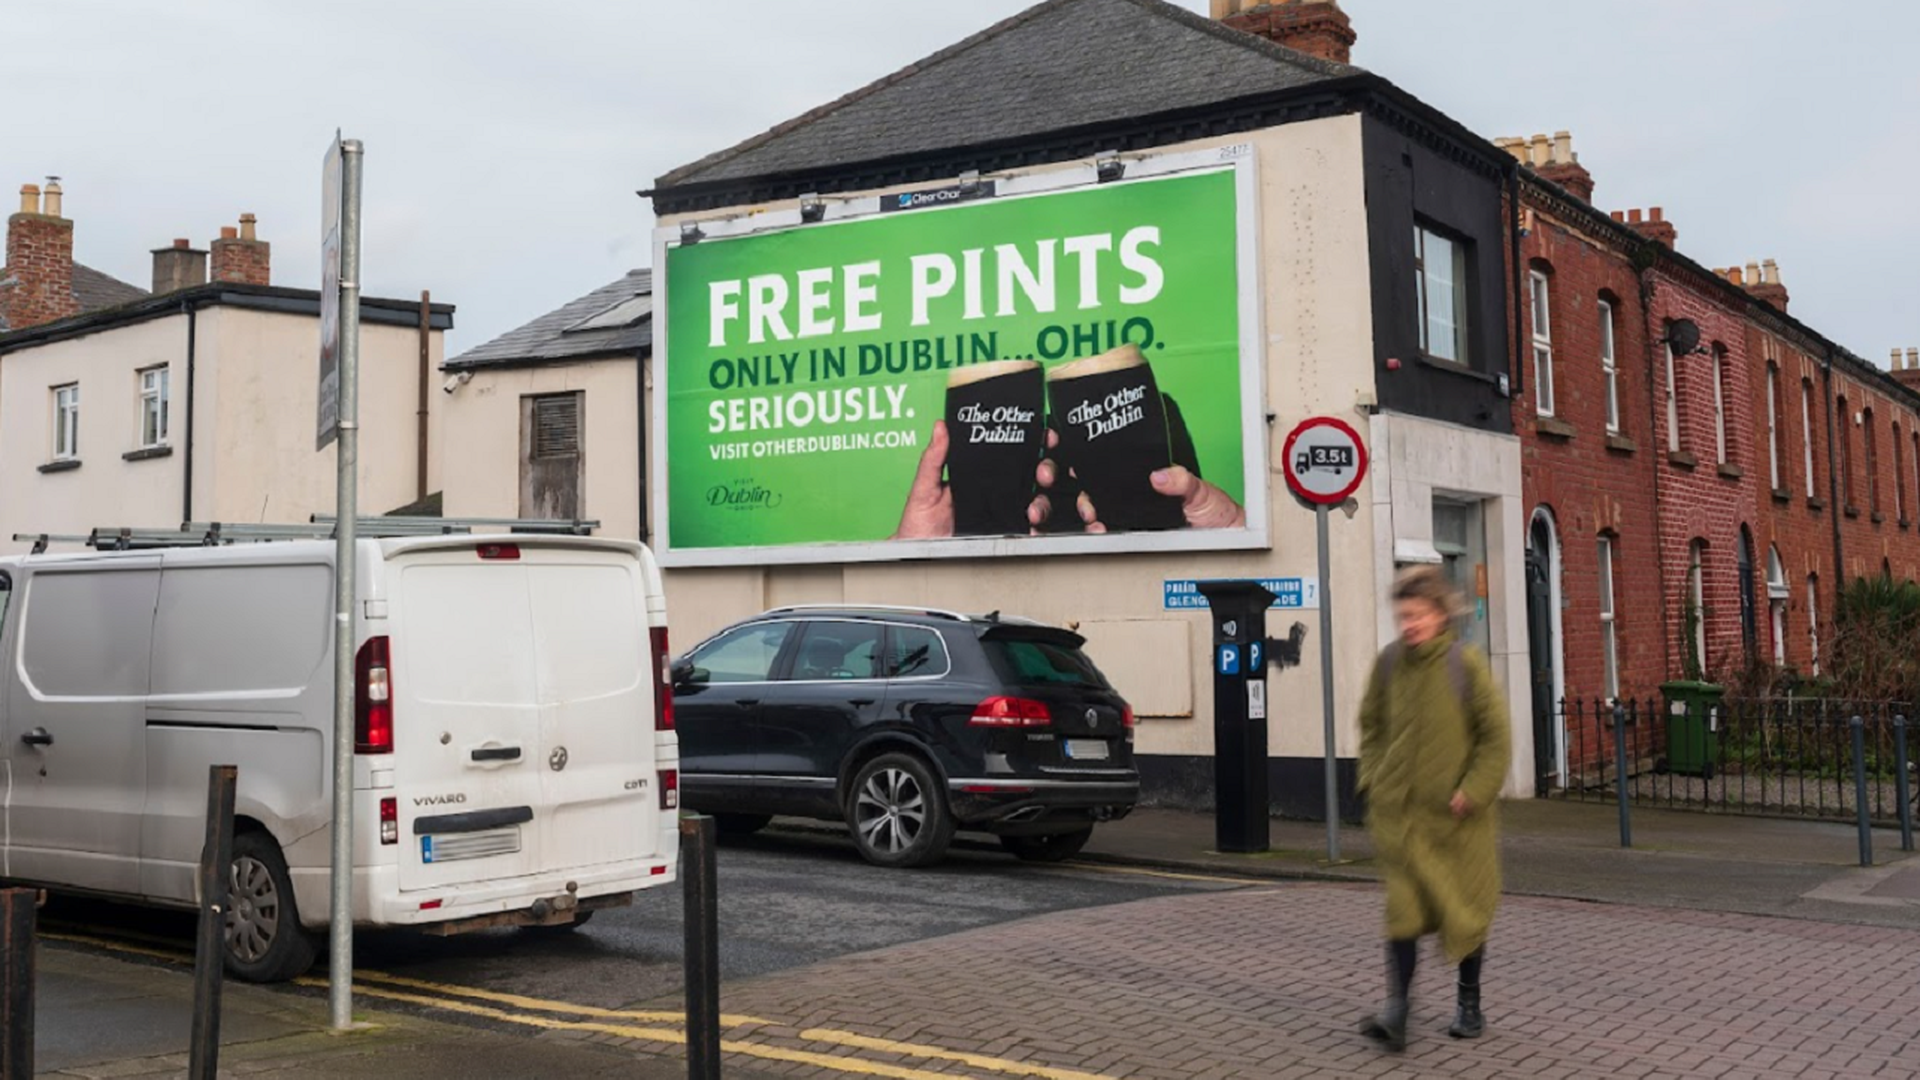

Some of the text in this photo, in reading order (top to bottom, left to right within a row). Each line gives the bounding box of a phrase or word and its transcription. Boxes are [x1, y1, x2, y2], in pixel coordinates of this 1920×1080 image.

[912, 192, 936, 204] Clear
[708, 225, 1164, 347] FREE PINTS
[709, 352, 799, 390] ONLY
[809, 346, 846, 382] IN
[709, 384, 915, 433] SERIOUSLY.
[957, 403, 1035, 423] The Other
[1067, 385, 1147, 425] The Other
[969, 424, 1025, 443] Dublin
[1086, 404, 1144, 442] Dublin
[709, 430, 916, 460] VISIT OTHERDUBLIN.COM
[706, 485, 782, 509] Dublin
[1168, 595, 1210, 607] GLENG
[1308, 584, 1315, 599] 7
[1223, 649, 1235, 671] P
[1251, 644, 1259, 667] P
[413, 793, 467, 807] VIVARO
